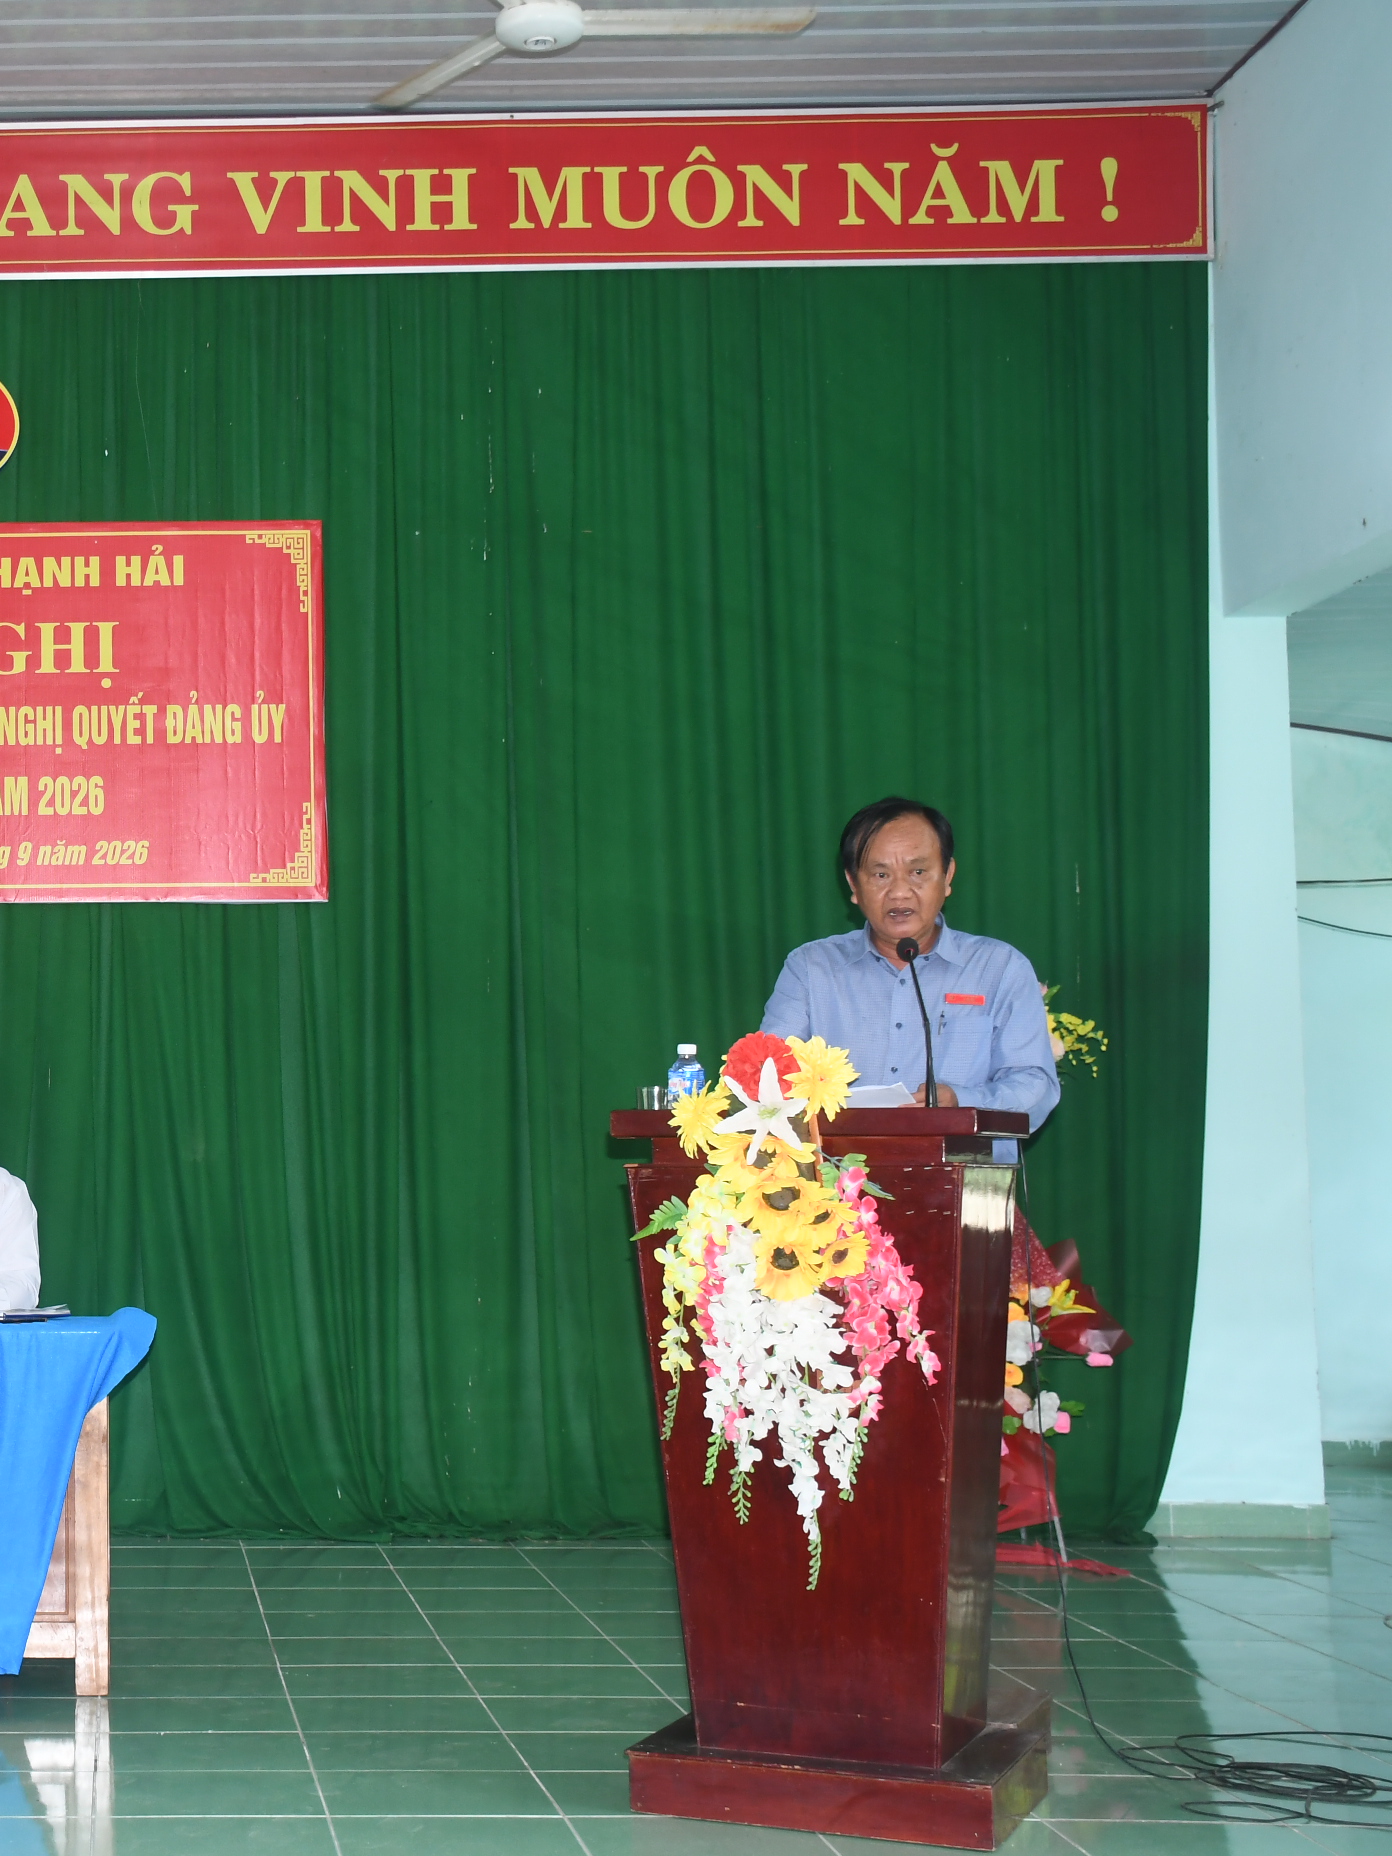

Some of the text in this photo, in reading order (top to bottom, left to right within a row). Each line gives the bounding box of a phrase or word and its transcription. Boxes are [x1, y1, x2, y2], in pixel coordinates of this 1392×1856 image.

[227, 168, 477, 234] VINH
[509, 146, 807, 230] MUÔN
[839, 143, 1065, 225] NĂM
[1101, 158, 1119, 222] !
[116, 545, 185, 587] HẢI
[72, 692, 157, 749] QUYẾT
[165, 691, 243, 744] ĐẢNG
[251, 690, 286, 744] ỦY
[38, 776, 105, 816] 2026
[16, 841, 32, 866] 9
[36, 840, 87, 865] năm
[92, 840, 149, 865] 2026
